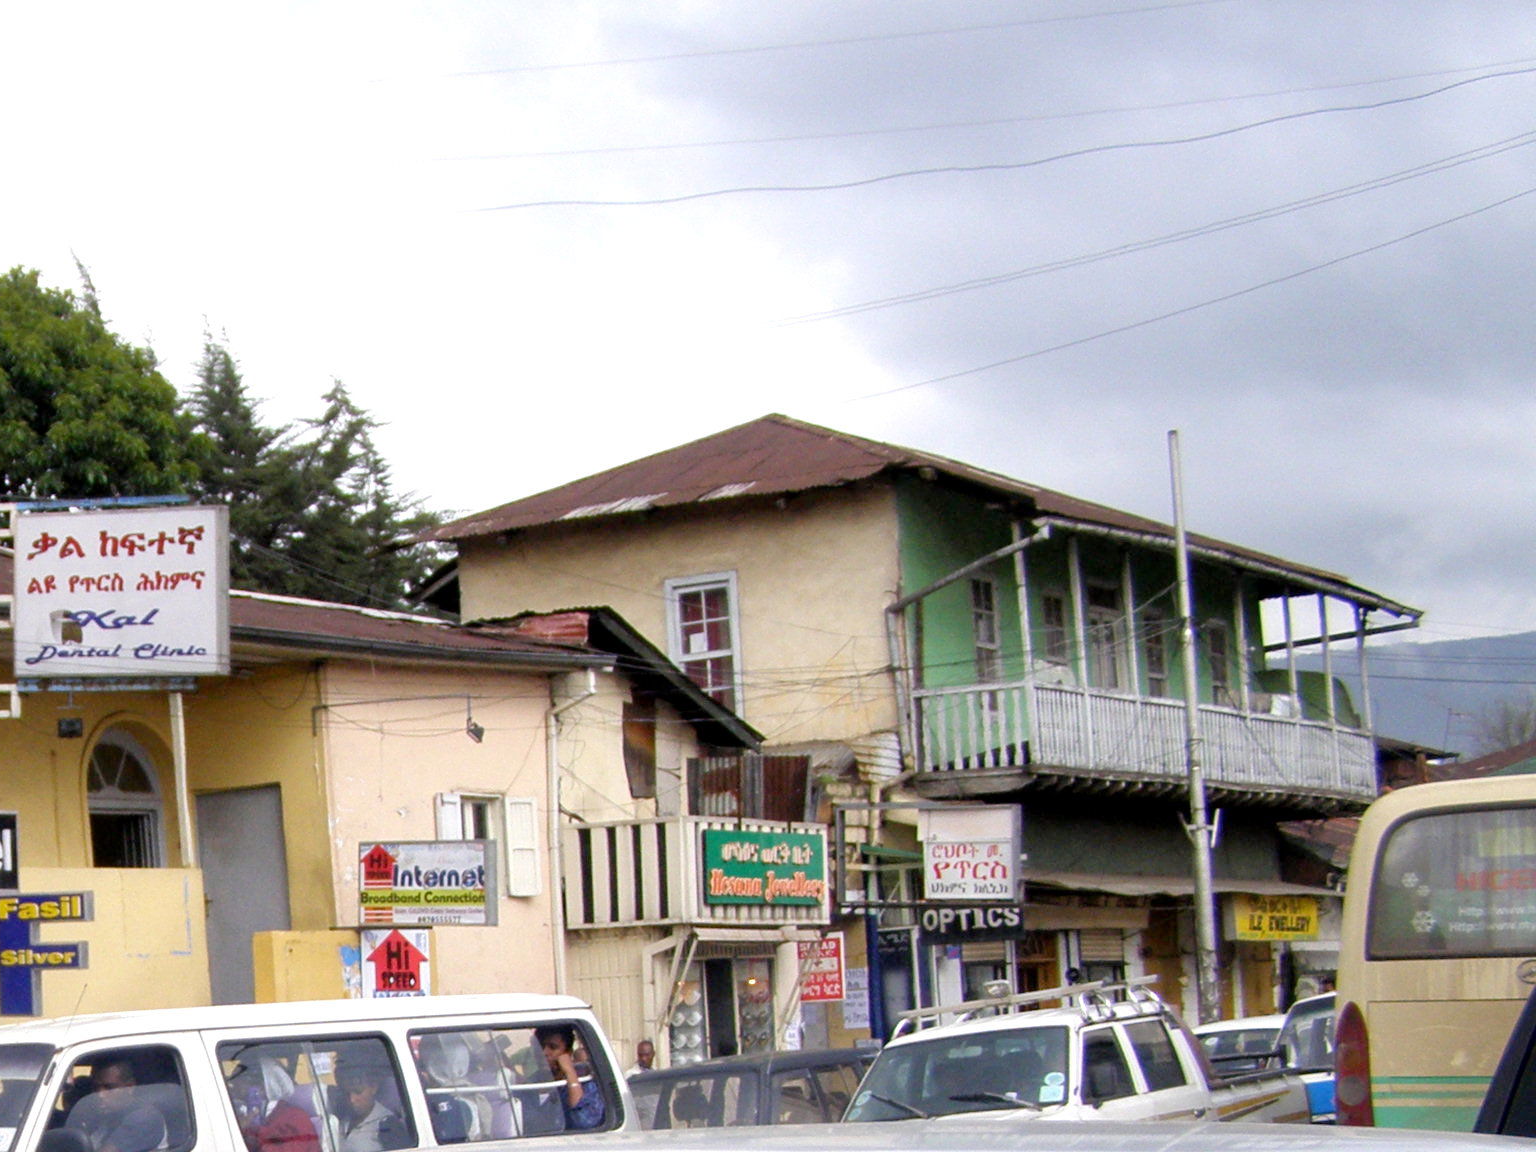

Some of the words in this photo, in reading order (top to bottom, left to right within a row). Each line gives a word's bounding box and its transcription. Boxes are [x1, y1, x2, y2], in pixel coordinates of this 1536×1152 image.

[27, 531, 85, 560] ቃል
[99, 525, 205, 557] ከፍተኛ
[27, 575, 57, 594] ልዩ
[68, 572, 124, 593] የጥርስ
[136, 570, 206, 592] ሕክምና
[68, 608, 160, 630] Kal
[25, 644, 123, 665] Dental
[133, 643, 207, 660] Clinic
[369, 854, 388, 869] Hi
[932, 860, 1008, 881] የጥርስ
[393, 864, 485, 887] Internet
[360, 891, 421, 904] Broadband
[424, 891, 485, 904] Connection
[923, 907, 1020, 934] OPTICS
[0, 948, 77, 967] Silver
[386, 941, 409, 971] Hi
[381, 971, 416, 989] SPEED
